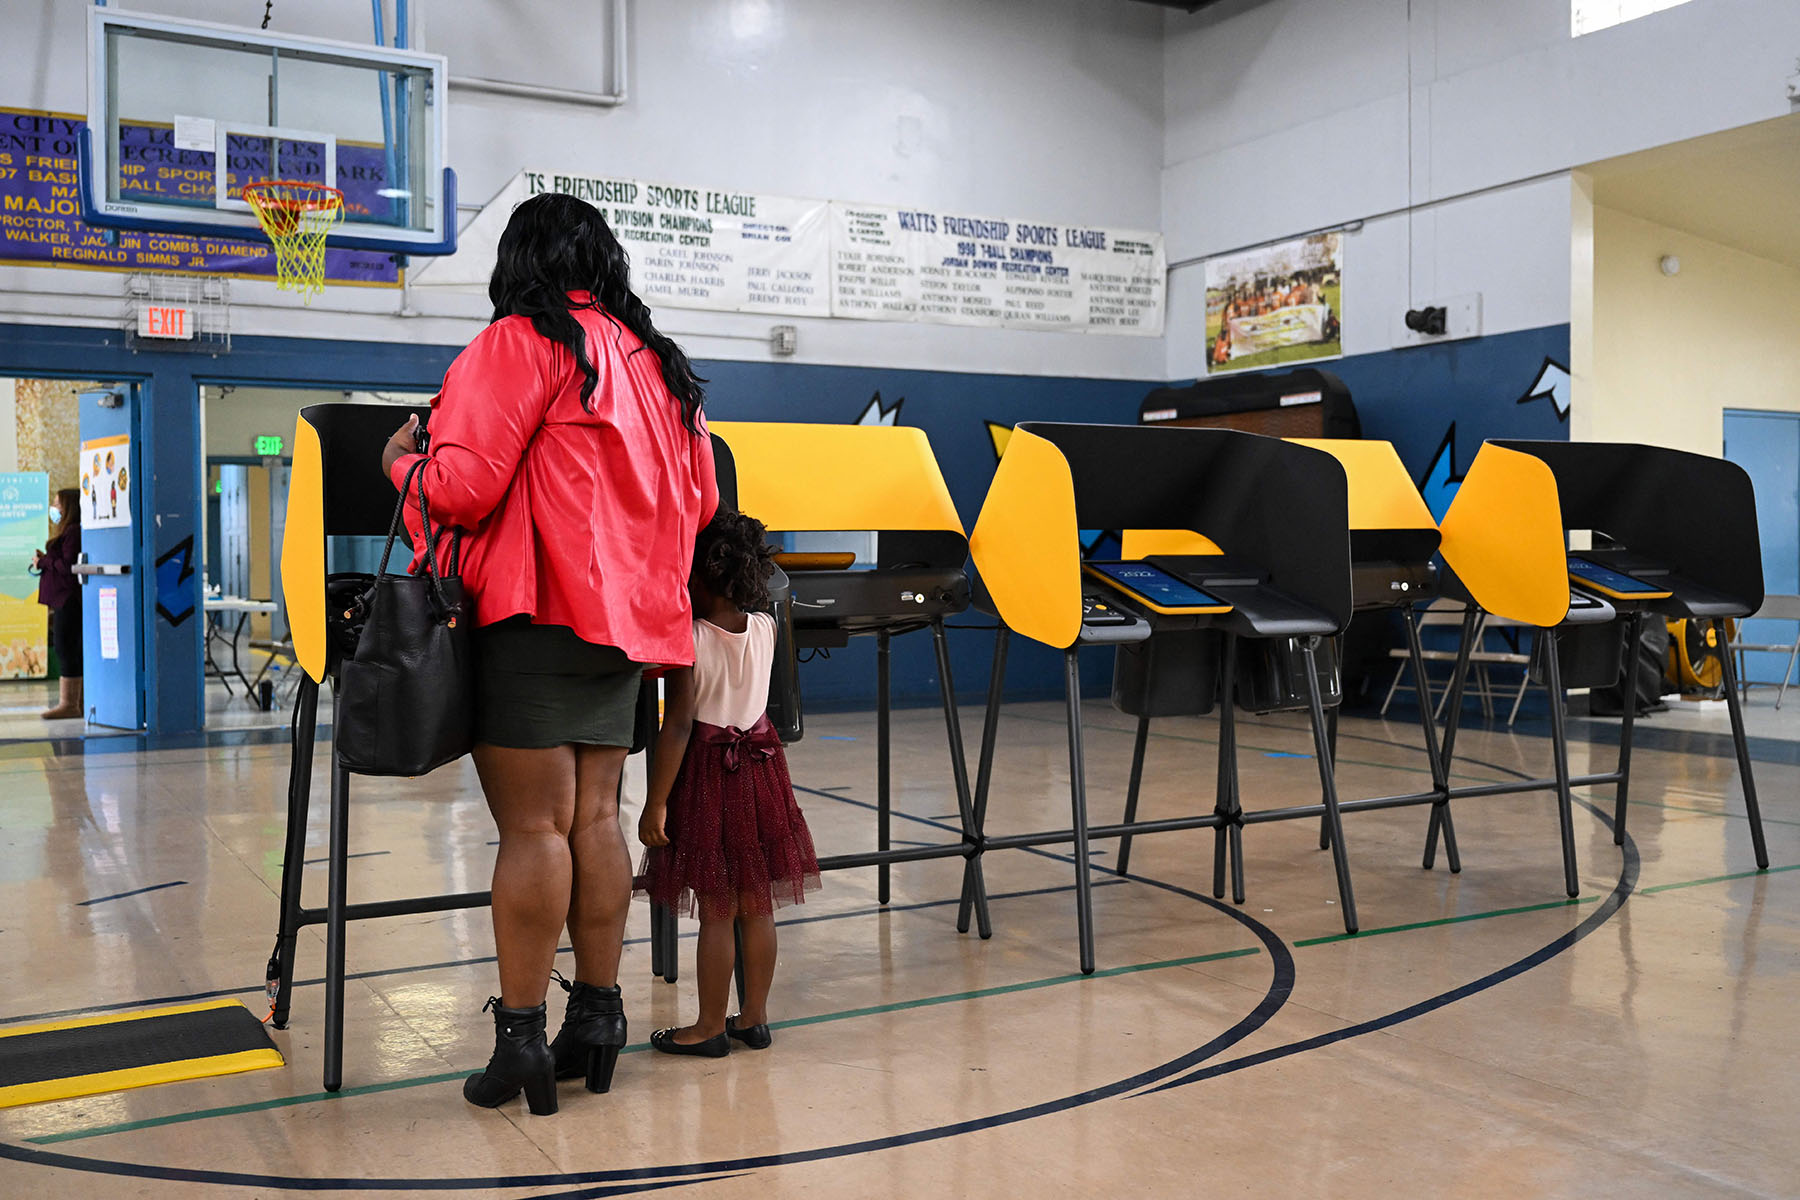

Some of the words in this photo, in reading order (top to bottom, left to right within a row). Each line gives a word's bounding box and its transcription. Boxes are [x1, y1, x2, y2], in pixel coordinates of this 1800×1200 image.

[14, 116, 78, 136] CITY
[227, 134, 319, 158] NGELES
[158, 167, 237, 185] SPORS
[4, 195, 80, 216] MAJO
[554, 176, 638, 204] FRIENDSHIP
[647, 184, 699, 211] SPORTS
[706, 191, 756, 218] LEAGUE
[614, 211, 654, 230] DIVISION
[660, 213, 713, 234] CHAMPIONS
[897, 210, 938, 233] WATTS
[943, 215, 1010, 243] FRIENDSHIP
[1016, 223, 1059, 247] SPORTS
[1065, 228, 1107, 251] LEAGUE
[5, 228, 75, 248] WALKER,
[149, 239, 203, 254] COMBS,
[624, 231, 674, 246] RECREATION
[679, 234, 711, 248] CENTER
[52, 246, 128, 264] REGINALD
[136, 252, 181, 268] SIMMS
[942, 256, 969, 268] JORDAN
[973, 259, 997, 271] DOWNS
[1001, 261, 1042, 275] RECREATION
[1045, 266, 1070, 277] CENTER
[1010, 247, 1054, 265] CHAMPIONS
[645, 272, 687, 283] CHARLES
[690, 273, 726, 287] HARRIS
[776, 269, 812, 281] JACKSON
[839, 299, 877, 309] ANTHONY
[921, 293, 958, 304] ANTHONY
[920, 304, 957, 315] ANTHONY
[149, 307, 187, 337] EXIT
